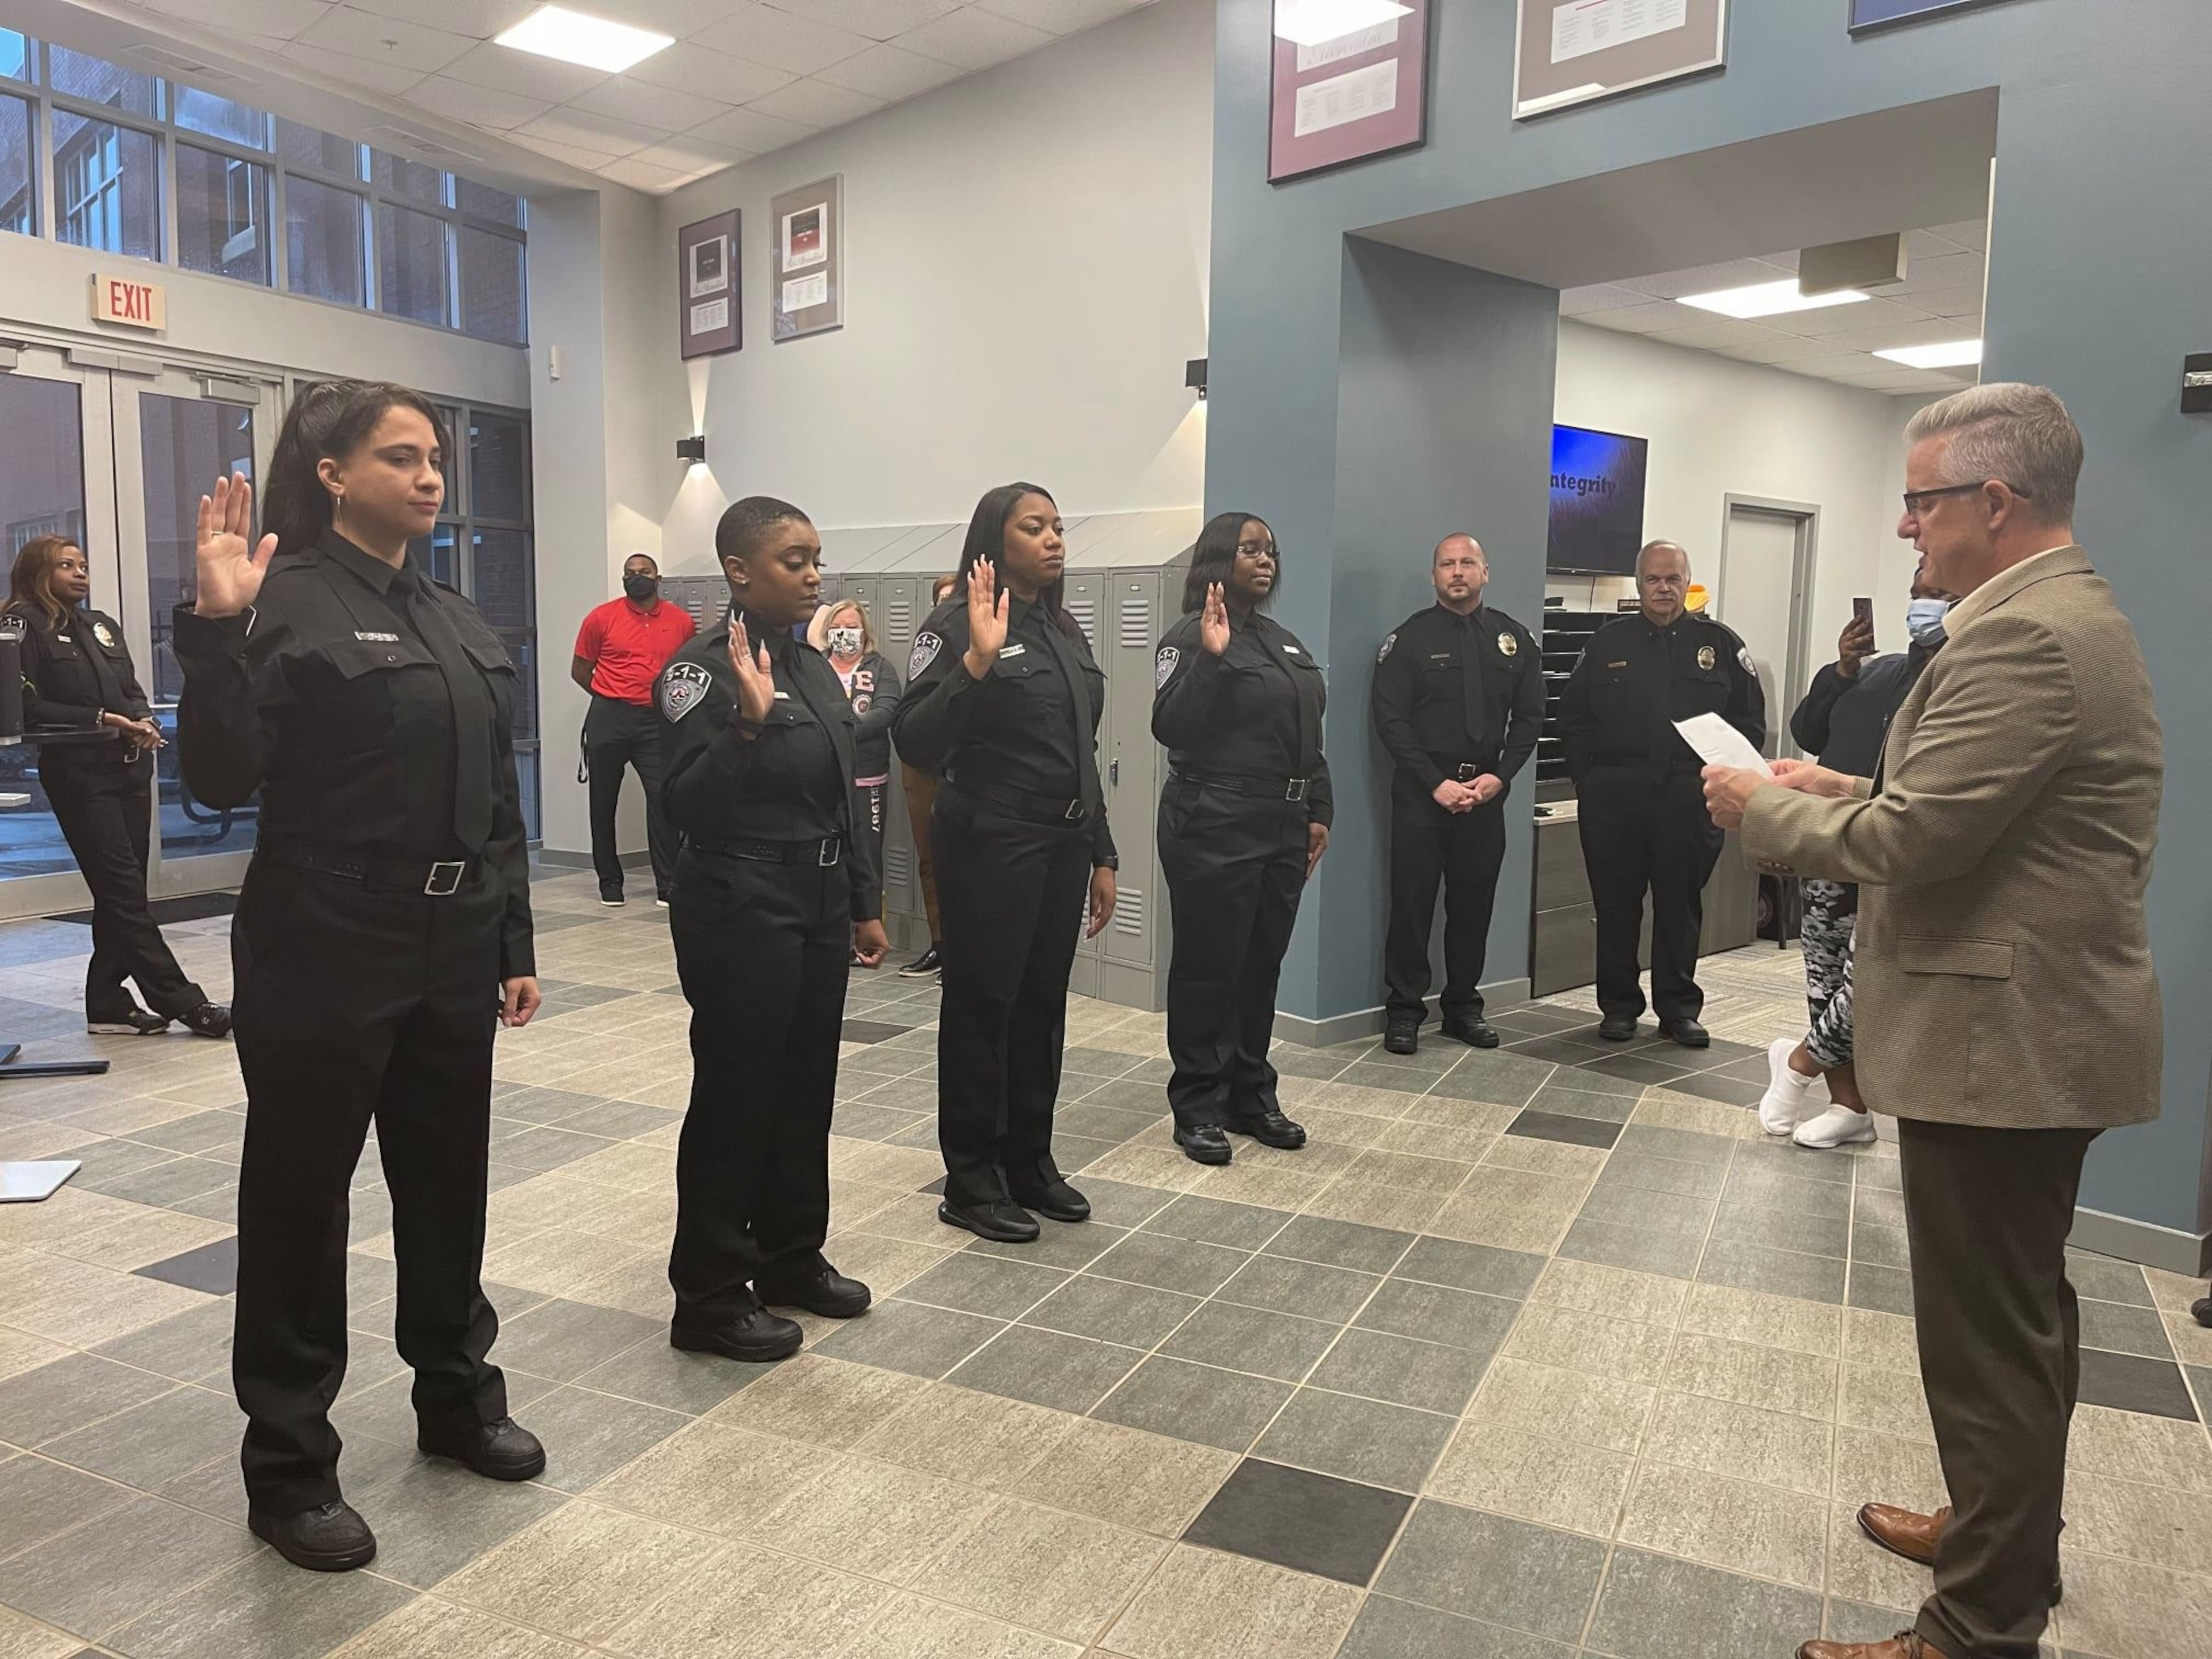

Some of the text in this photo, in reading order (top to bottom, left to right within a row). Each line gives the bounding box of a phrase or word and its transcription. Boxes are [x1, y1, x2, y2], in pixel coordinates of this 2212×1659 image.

[110, 281, 151, 321] EXIT
[666, 665, 706, 685] 9-1-1
[855, 671, 874, 692] E
